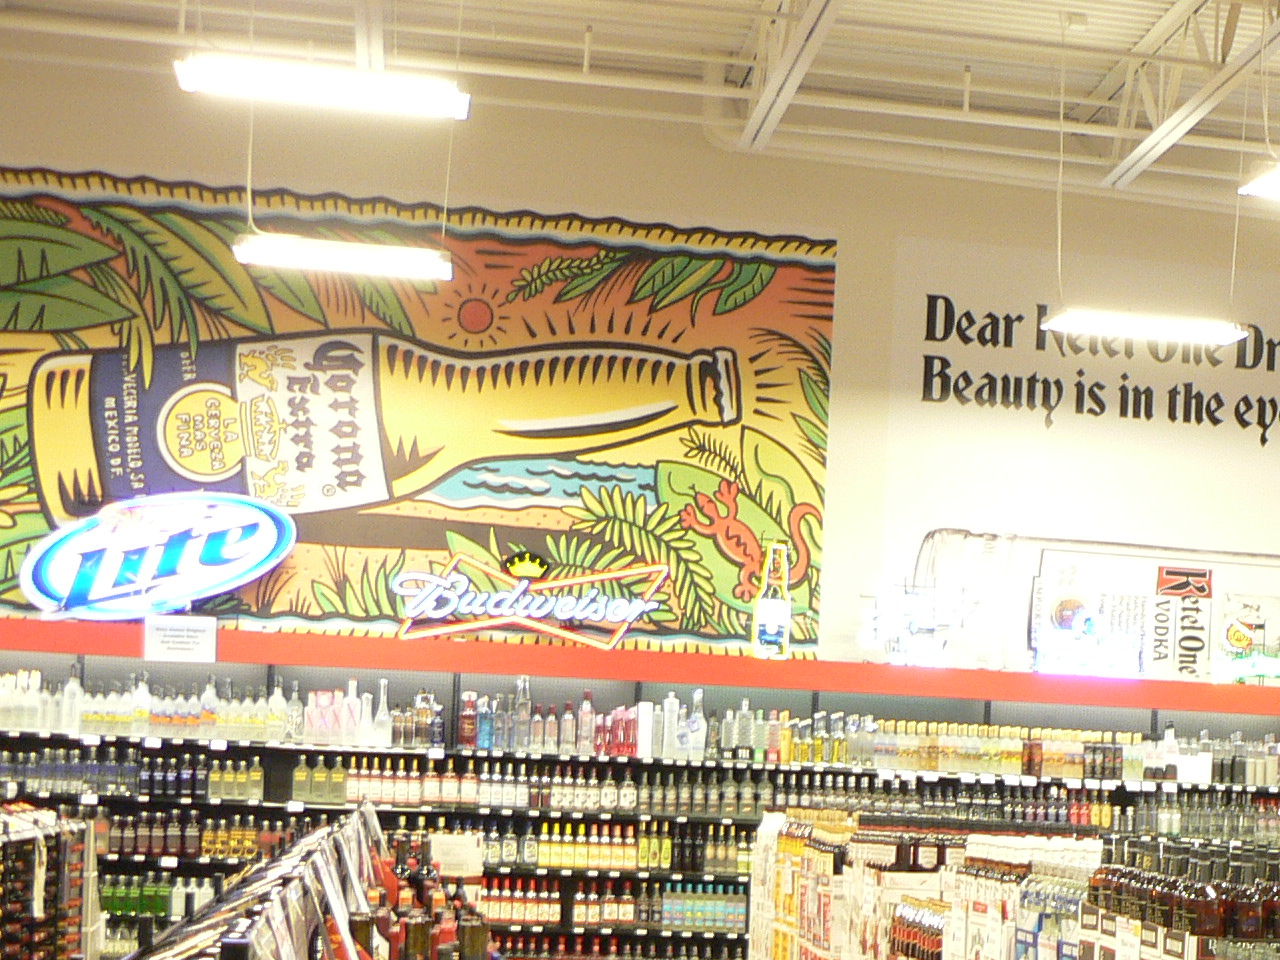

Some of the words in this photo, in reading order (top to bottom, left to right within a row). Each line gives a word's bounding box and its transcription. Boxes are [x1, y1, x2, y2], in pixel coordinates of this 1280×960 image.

[924, 294, 1025, 348] Dear
[286, 374, 320, 472] Extra
[303, 340, 367, 492] Corona
[921, 354, 1064, 429] Beauty
[1074, 368, 1107, 417] is
[1118, 372, 1154, 421] in
[1167, 381, 1226, 427] the
[176, 412, 195, 458] FINA
[193, 413, 208, 452] MAS
[205, 398, 226, 471] CERVEZA
[223, 417, 239, 443] LA
[59, 522, 260, 611] Lite
[391, 571, 661, 623] Budweiser
[1152, 599, 1172, 662] VODKA
[1158, 567, 1212, 633] Ketel
[1178, 633, 1206, 676] One
